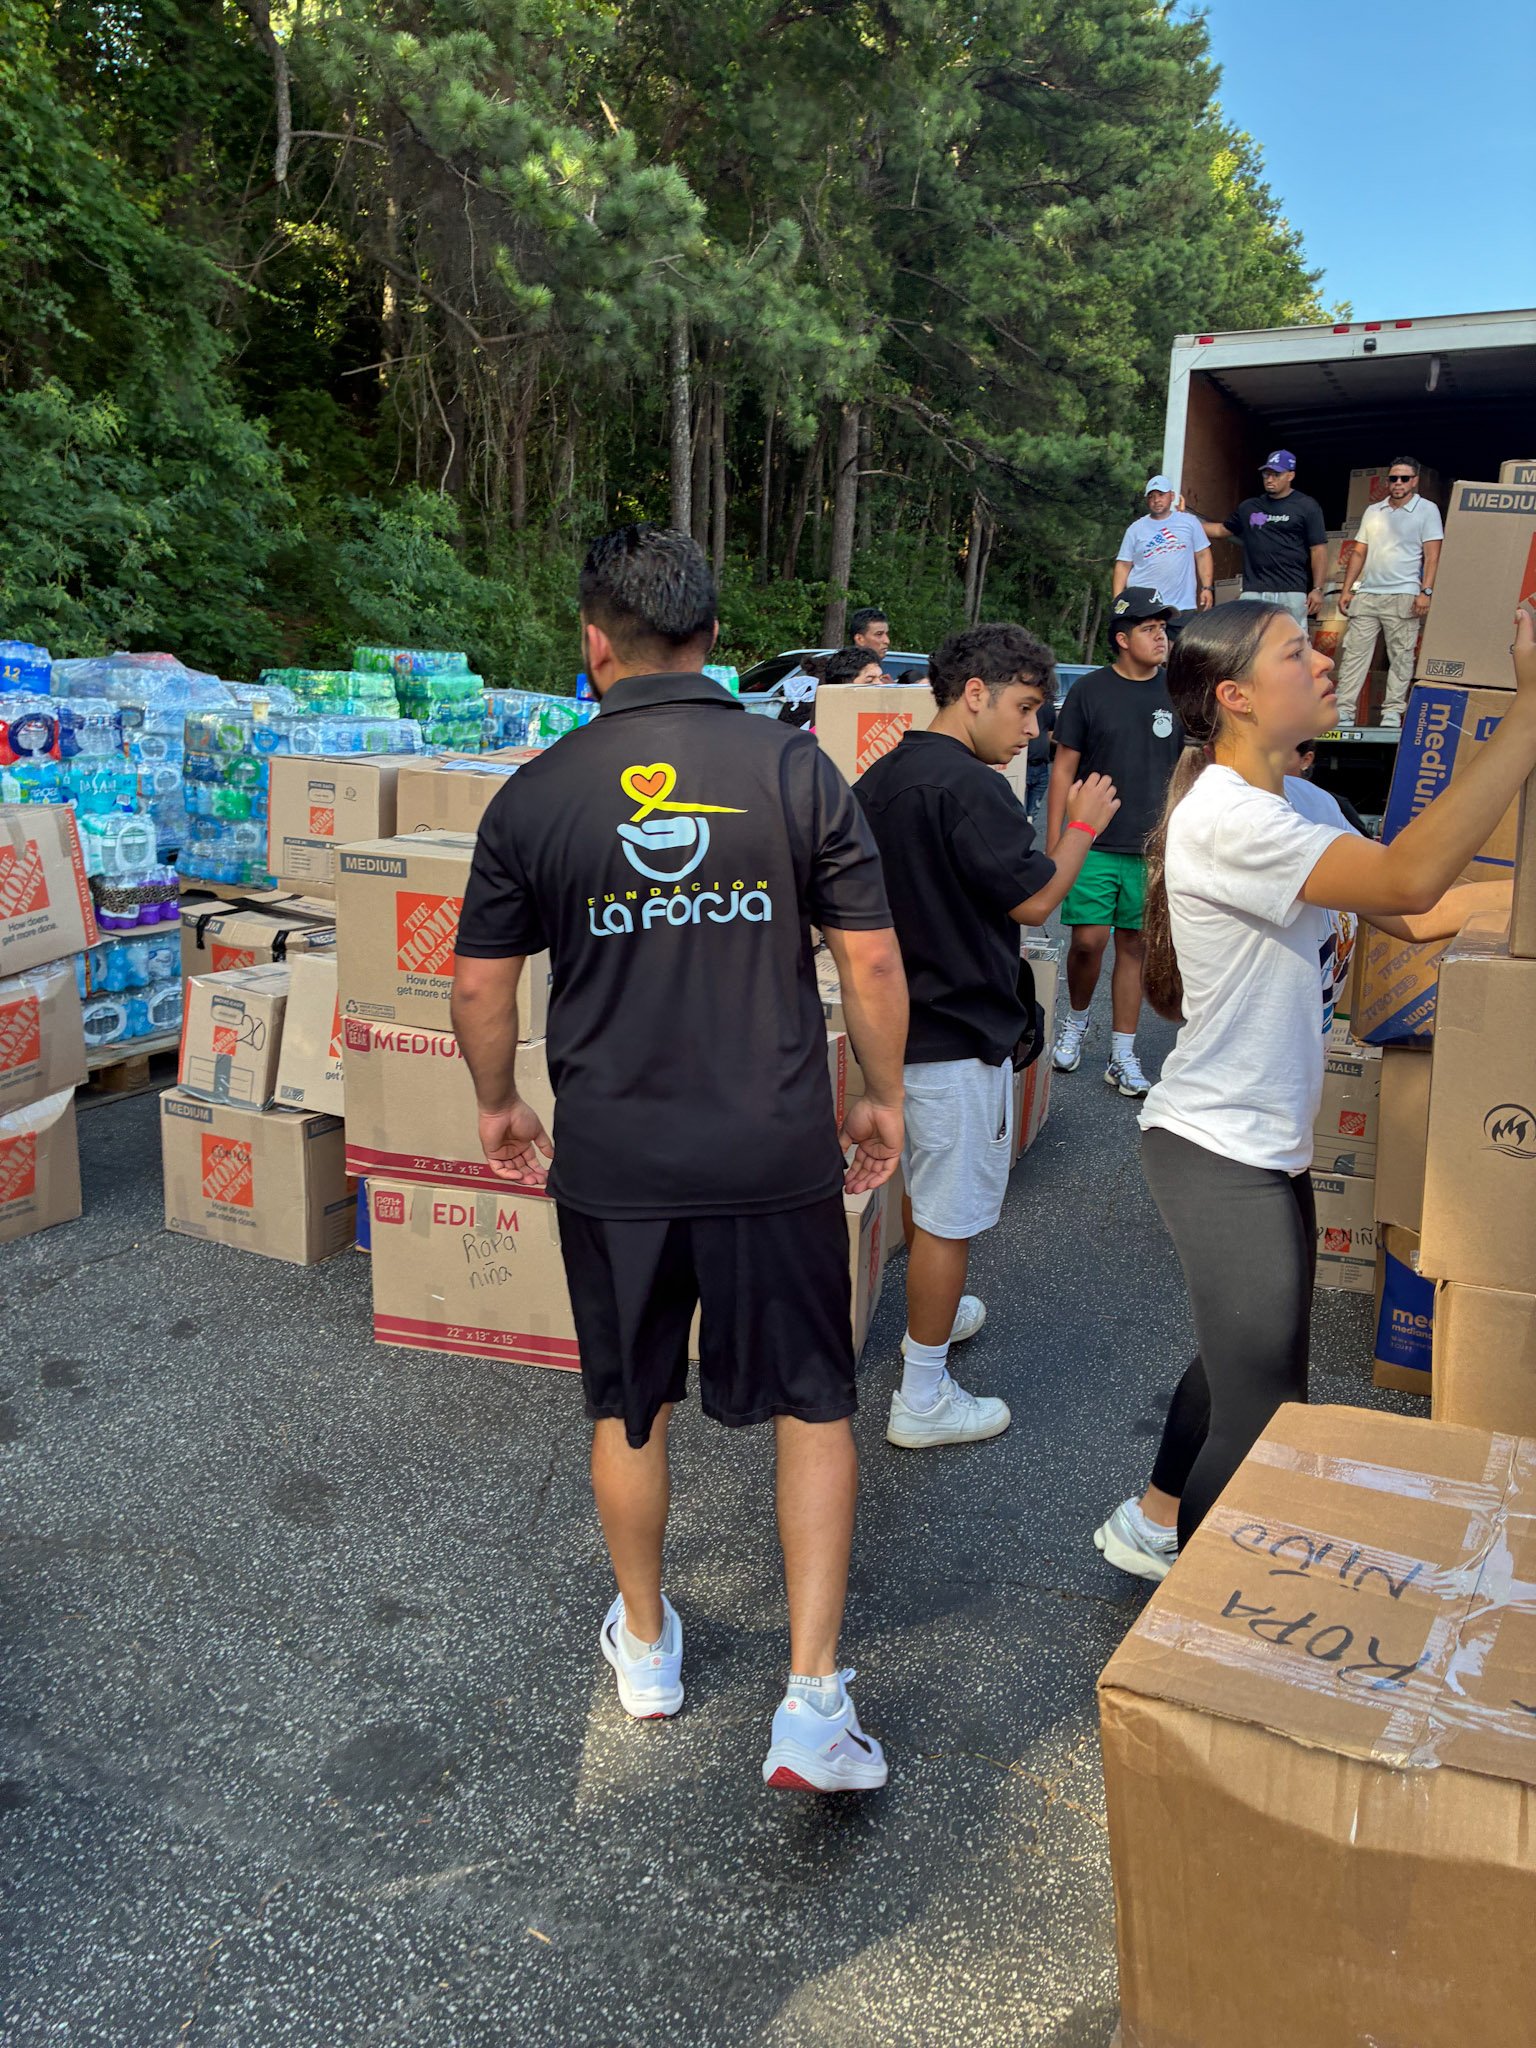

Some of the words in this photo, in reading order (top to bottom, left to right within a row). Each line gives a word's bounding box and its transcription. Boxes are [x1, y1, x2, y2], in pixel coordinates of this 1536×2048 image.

[1467, 492, 1536, 511] MEDIU
[1149, 589, 1162, 603] A
[3, 665, 21, 680] 12
[862, 719, 888, 744] THE
[1414, 702, 1429, 746] mediana
[857, 714, 912, 772] HOME
[345, 856, 402, 875] MEDIUM
[587, 879, 768, 907] FUNDACIÓN
[8, 921, 28, 932] How
[403, 902, 432, 932] THE
[406, 974, 427, 986] How
[429, 976, 453, 989] doer
[397, 986, 413, 997] get
[414, 988, 439, 1000] more
[235, 1014, 266, 1051] 20
[374, 1029, 465, 1059] MEDIU
[1327, 1062, 1359, 1074] MALL
[168, 1101, 209, 1121] MEDIUM
[1312, 1181, 1340, 1192] MALL
[379, 1206, 400, 1219] GEAR
[410, 1203, 519, 1232] EDIM
[1221, 1590, 1432, 1690] ROPA
